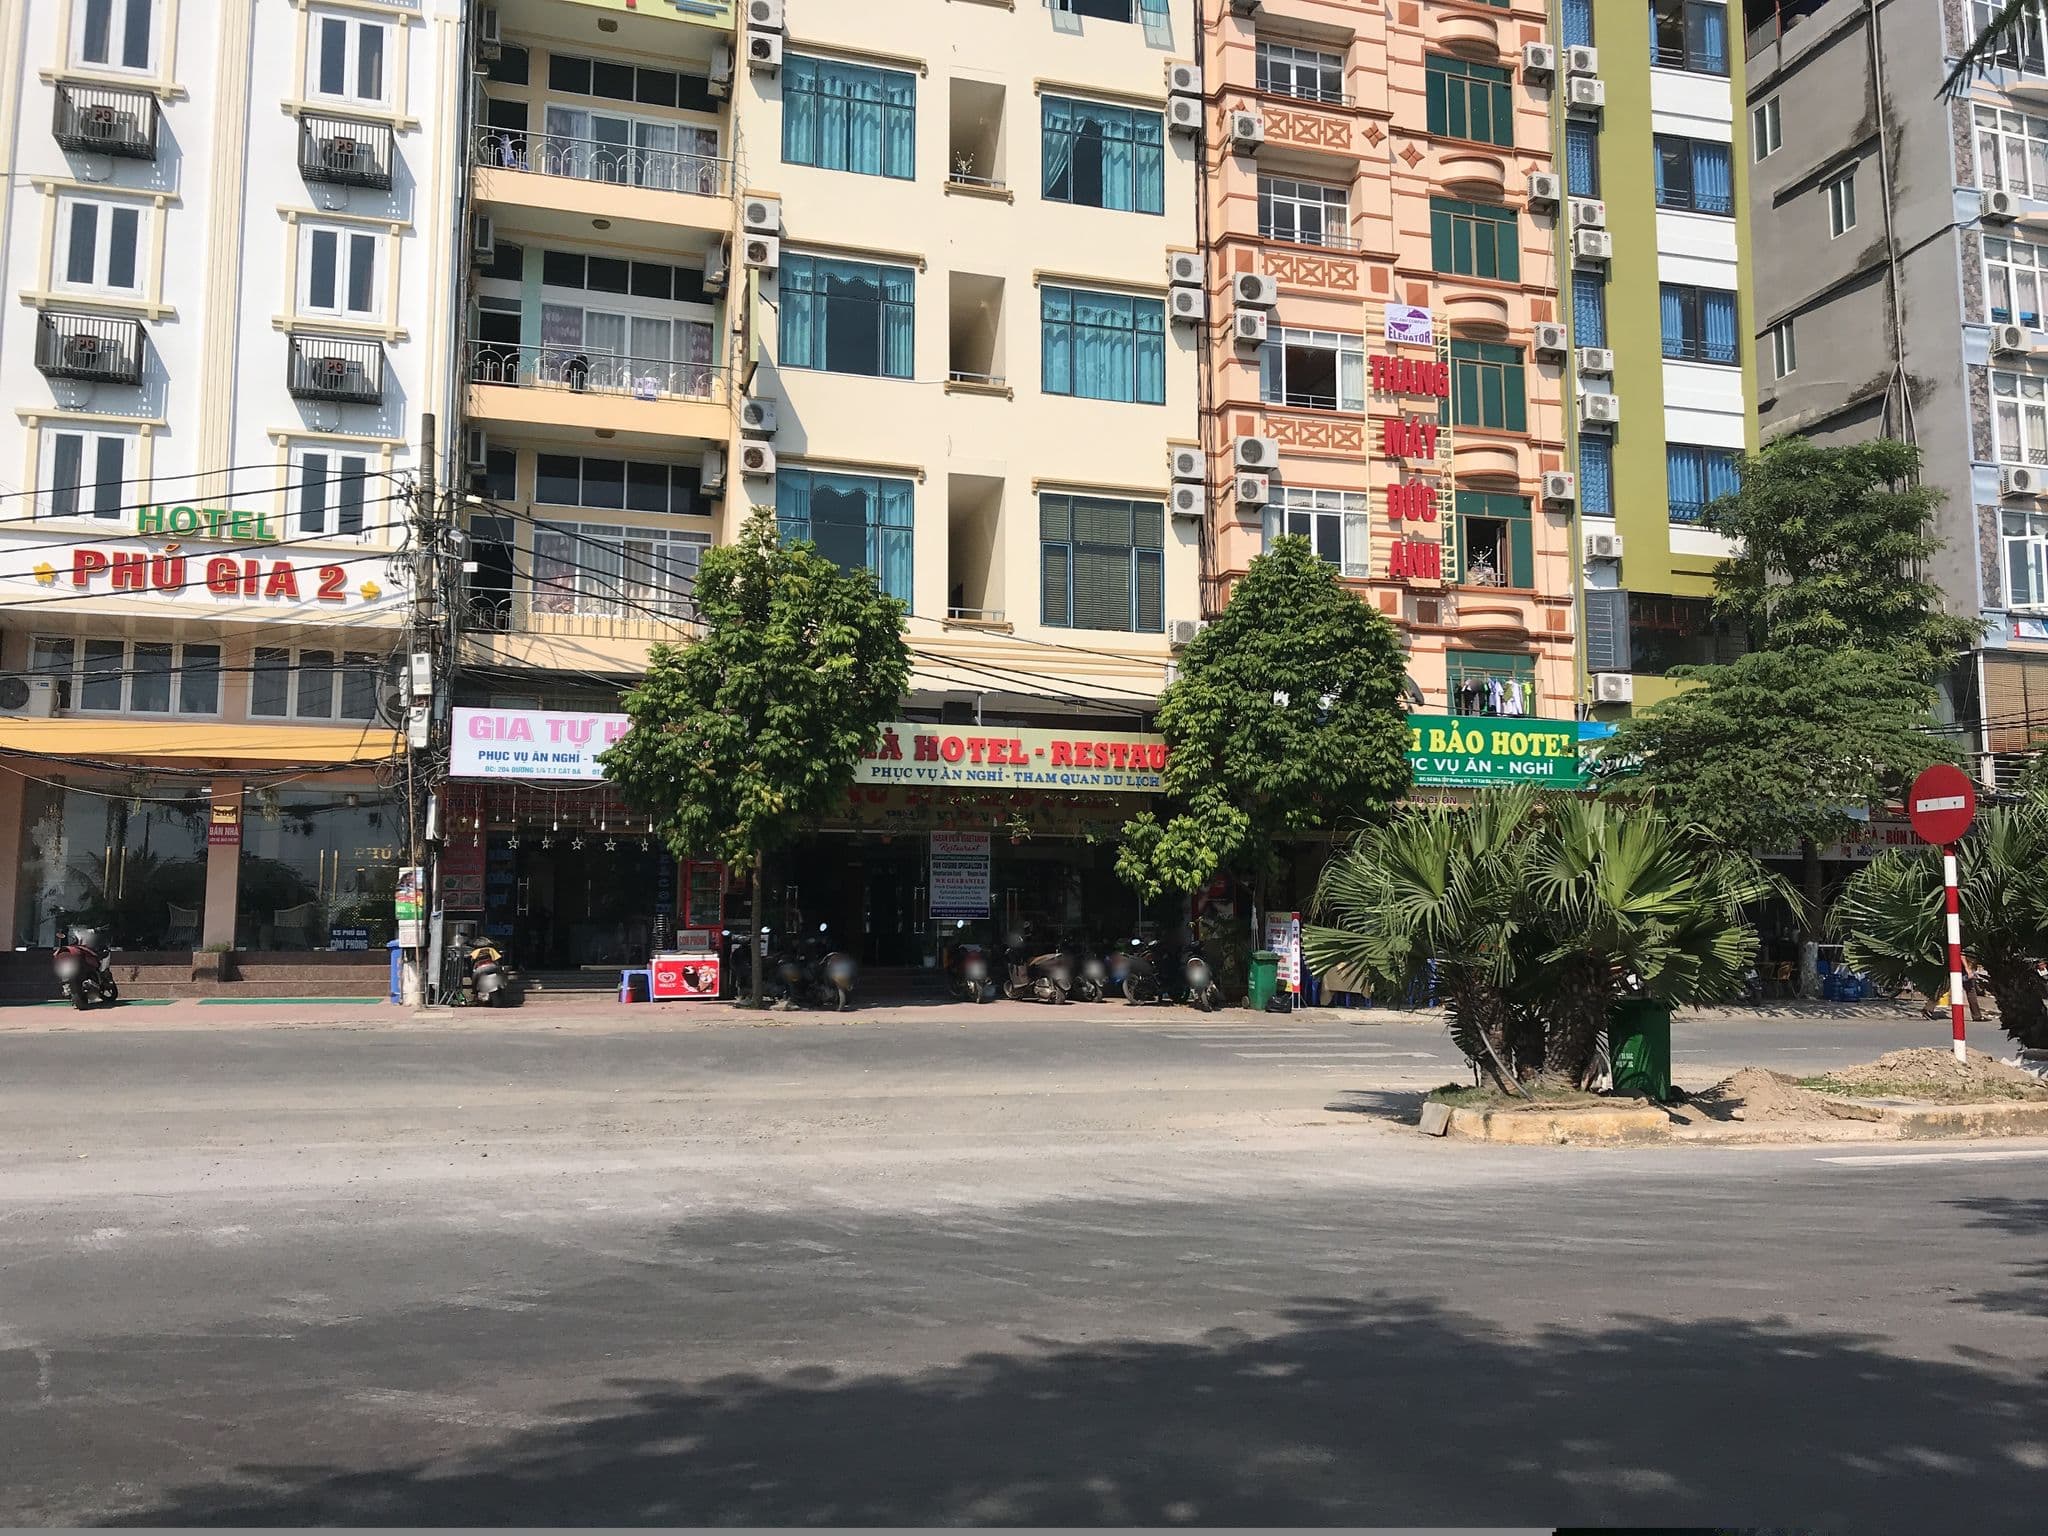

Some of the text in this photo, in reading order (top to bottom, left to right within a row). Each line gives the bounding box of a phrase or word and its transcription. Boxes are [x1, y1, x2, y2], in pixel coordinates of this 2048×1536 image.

[1388, 325, 1431, 344] ELEVATOR
[1369, 355, 1449, 397] THANG
[1383, 416, 1438, 460] MÁY
[1387, 477, 1438, 522] ĐỨC
[137, 504, 279, 542] HOTEL
[72, 544, 347, 601] PHÚ GIA 2
[1389, 541, 1441, 579] ANH
[469, 715, 534, 742] GIA
[546, 718, 599, 749] TỰ
[914, 733, 1029, 765] HOTEL
[1429, 719, 1484, 755] BẢO
[1491, 731, 1574, 758] HOTEL
[478, 750, 510, 762] PHỤC
[514, 752, 529, 763] VỤ
[532, 750, 548, 762] ĂN
[1434, 758, 1460, 774] VỤ
[1465, 756, 1491, 773] ĂN
[871, 766, 1160, 788] PHỤC VỤ ĂN NGHỈ THAM QUAN DU LỊCH
[1886, 827, 1907, 845] BÚN
